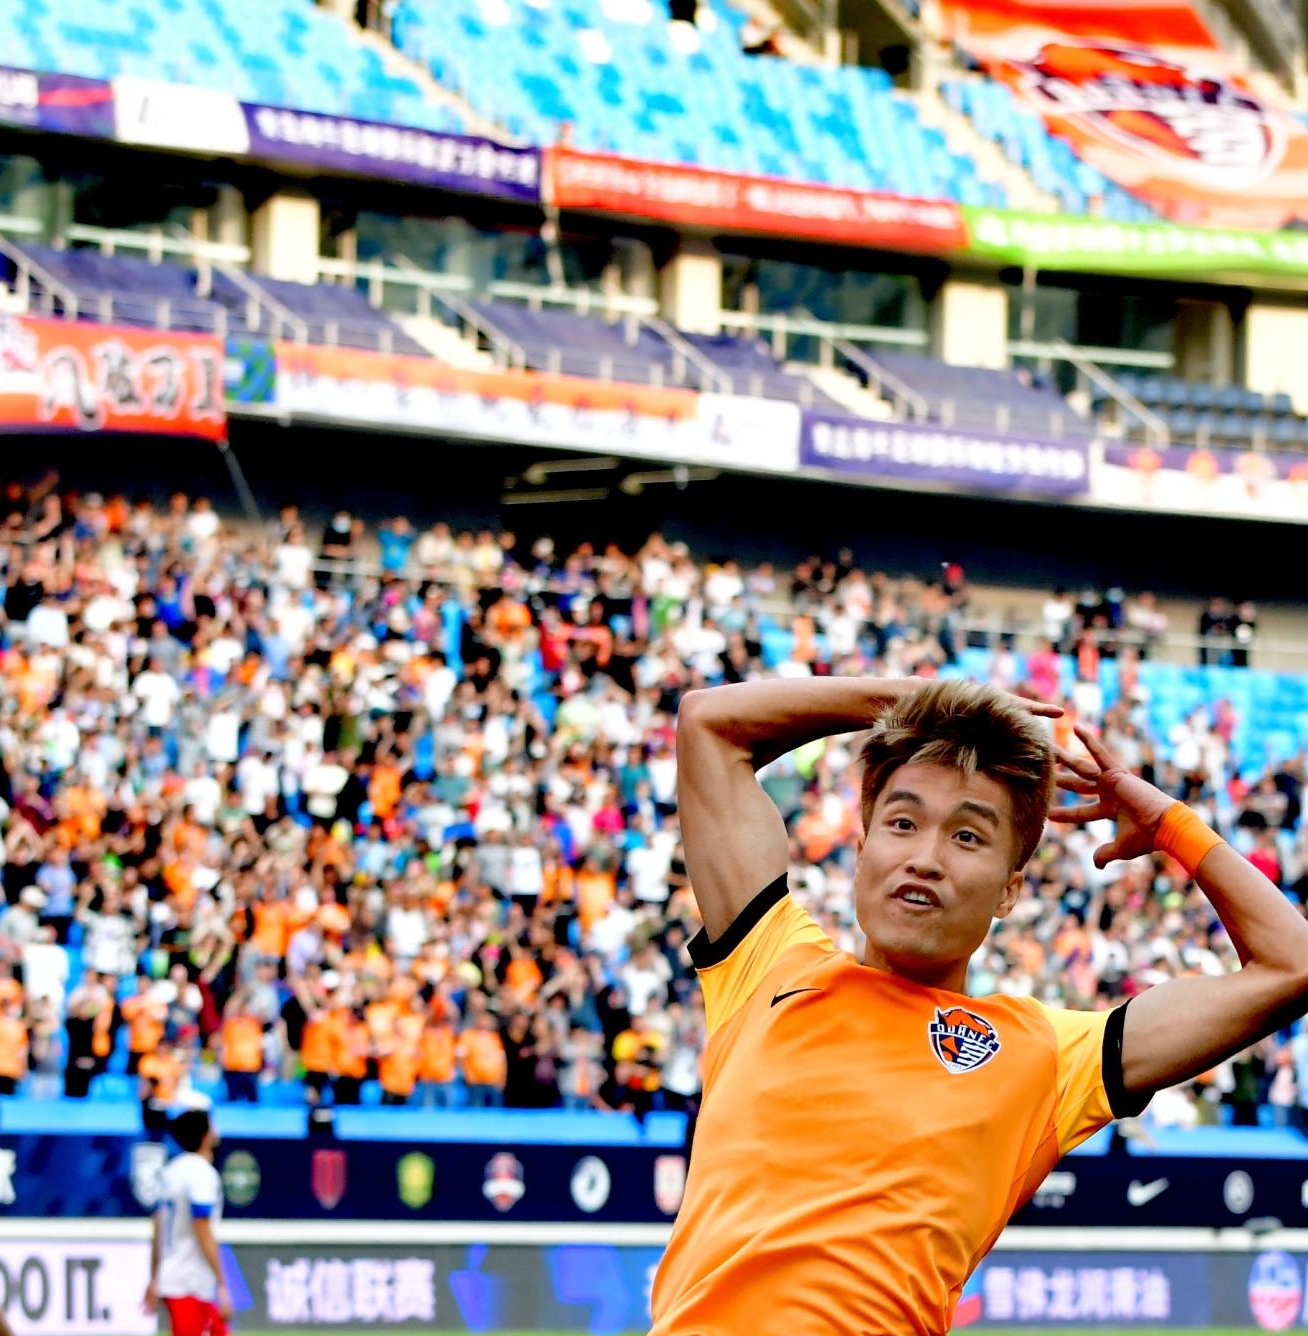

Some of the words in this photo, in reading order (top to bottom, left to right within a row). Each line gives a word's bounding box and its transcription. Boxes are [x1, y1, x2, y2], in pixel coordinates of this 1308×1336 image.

[64, 1257, 112, 1322] IT.
[265, 1257, 437, 1323] 诚信联赛
